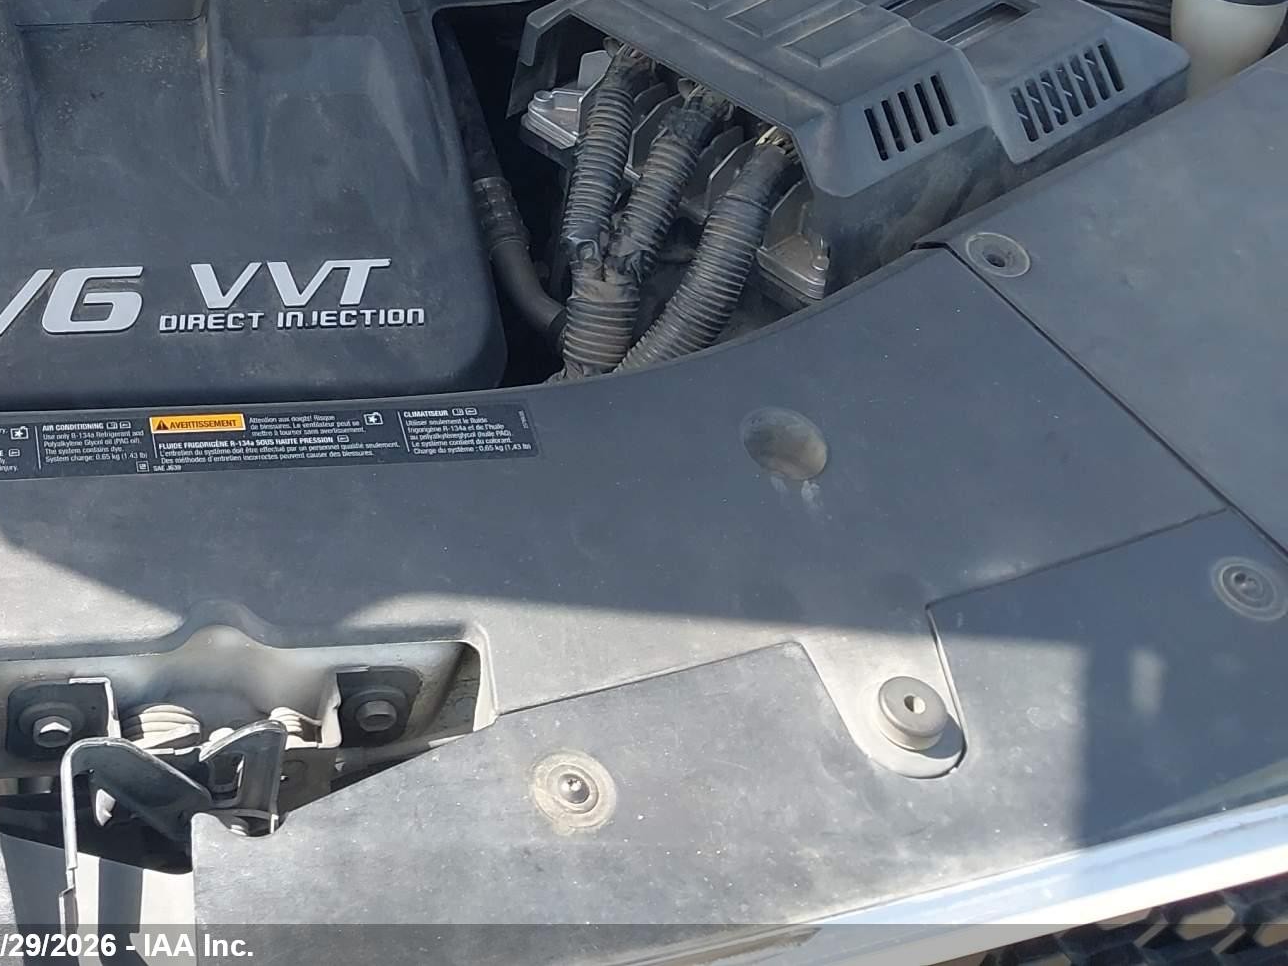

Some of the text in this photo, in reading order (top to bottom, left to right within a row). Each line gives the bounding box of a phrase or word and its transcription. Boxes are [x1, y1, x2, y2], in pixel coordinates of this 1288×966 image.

[190, 258, 391, 308] VVT
[159, 308, 425, 332] DIRECT INJECTION
[56, 423, 103, 431] CONDITIONING
[170, 420, 236, 429] AVERTISSEMENT
[337, 420, 350, 428] peut
[44, 440, 82, 448] Polyalkylene
[71, 454, 94, 462] charge:
[280, 452, 305, 460] peuvent
[0, 465, 18, 473] injury.
